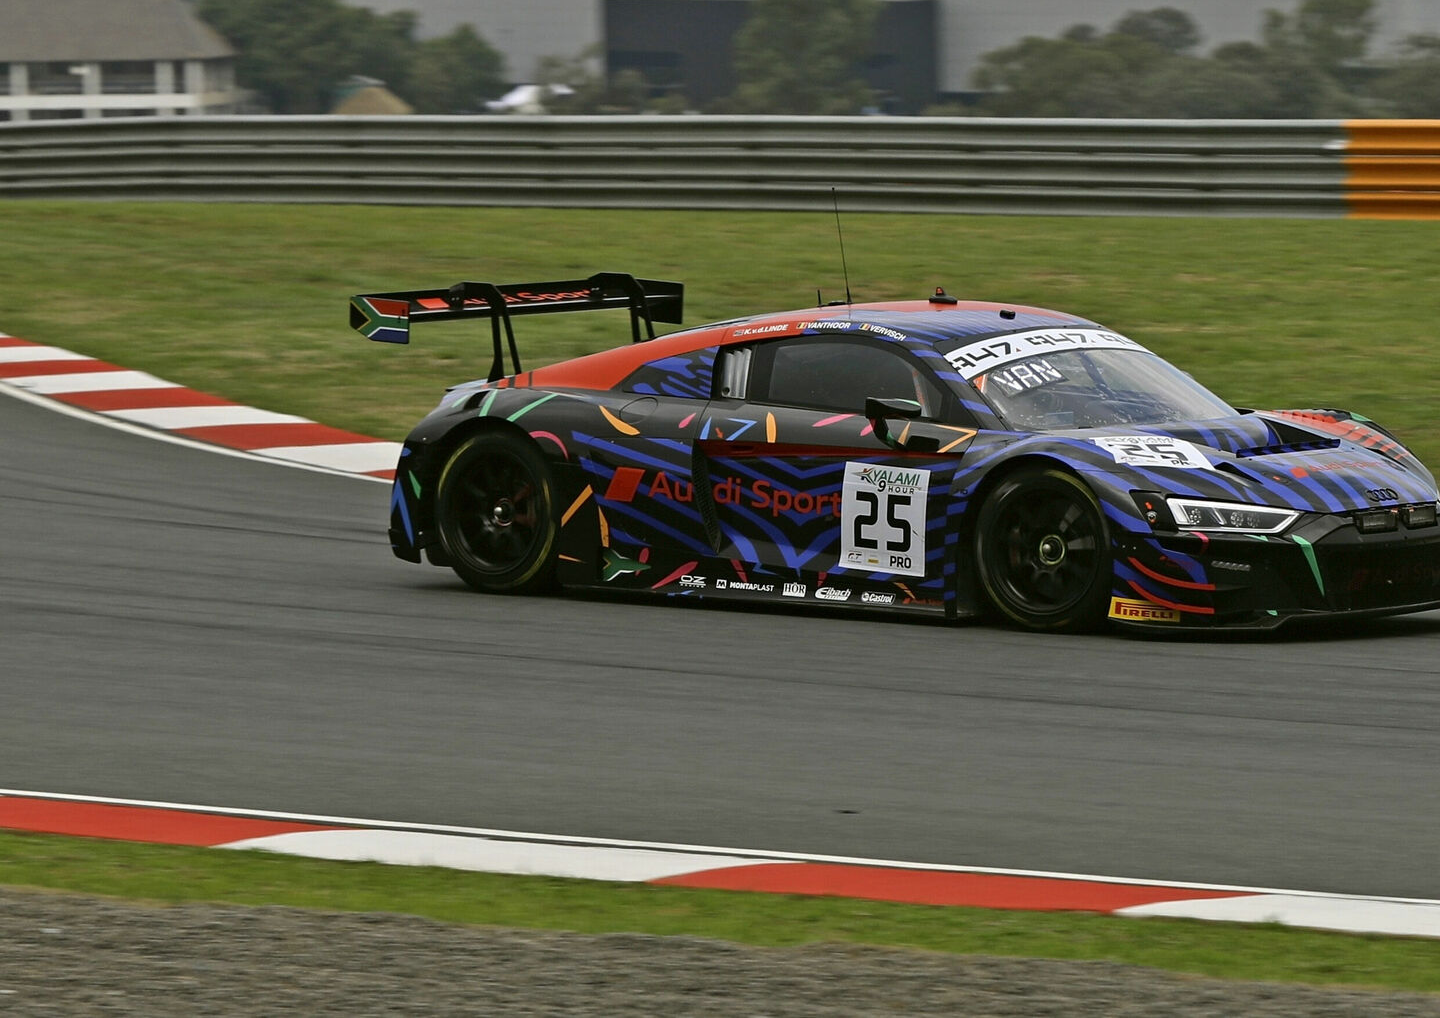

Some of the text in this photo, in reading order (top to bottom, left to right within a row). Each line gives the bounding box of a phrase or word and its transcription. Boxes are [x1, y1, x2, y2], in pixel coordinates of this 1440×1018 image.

[807, 321, 851, 329] VANTHOOR
[869, 324, 907, 341] VERVISCH
[992, 359, 1063, 391] VAN
[1108, 443, 1189, 461] 25
[862, 468, 920, 487] KYALAMI
[648, 471, 842, 518] Audi Sport
[877, 480, 915, 494] 9 HOUR
[853, 490, 912, 553] 25
[889, 555, 912, 569] PRO
[729, 581, 775, 592] MONTAPLAST
[815, 586, 852, 600] Eibach
[869, 593, 893, 603] Castrol
[1115, 601, 1173, 619] PIRELLI
